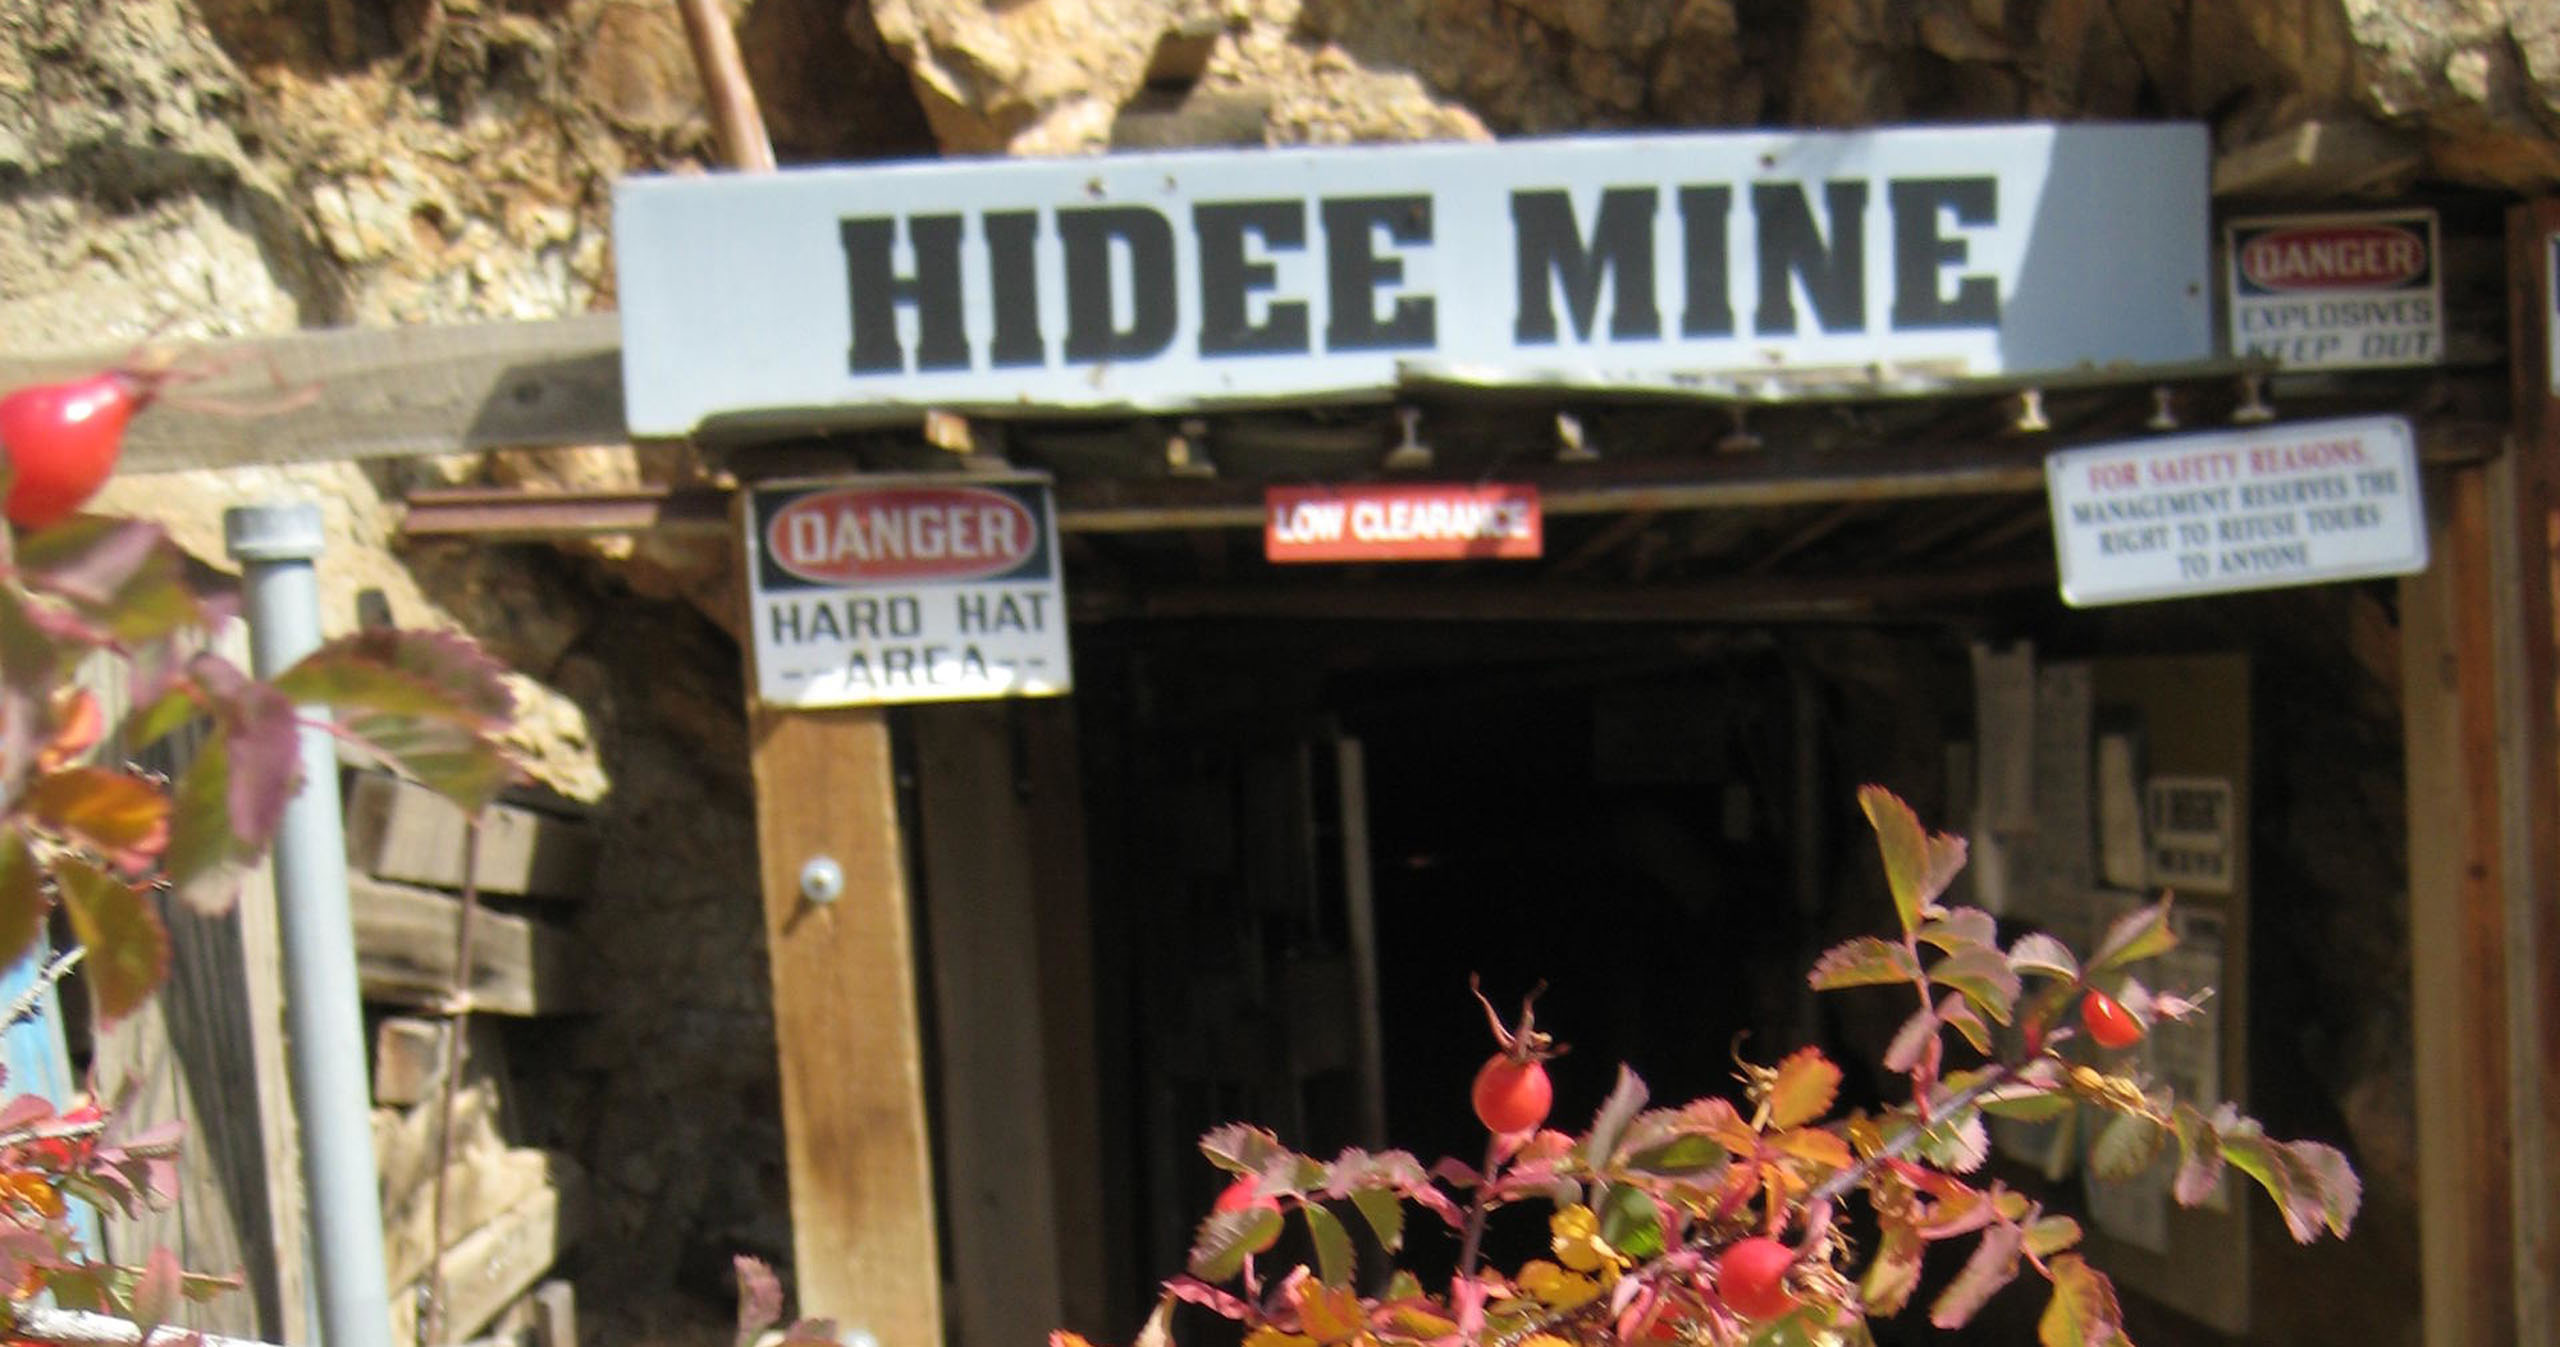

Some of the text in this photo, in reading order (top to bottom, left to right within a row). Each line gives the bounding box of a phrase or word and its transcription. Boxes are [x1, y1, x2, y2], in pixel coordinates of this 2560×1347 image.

[840, 176, 1999, 376] HIDEE MINE
[2251, 237, 2415, 280] DANGER
[2242, 300, 2432, 331] EXPLOSIVES
[2361, 333, 2431, 358] OUT
[2089, 461, 2139, 492] FOR
[2148, 452, 2237, 484] SAFETY
[2072, 470, 2396, 525] MANAGEMENT RESERVES THE
[788, 506, 1018, 564] DANGER
[1275, 499, 1531, 544] LOW CLEARANCE
[2100, 503, 2381, 555] RIGHT TO REFUSE TOURS
[2179, 541, 2307, 578] TO ANYONE
[771, 590, 1050, 643] HARD HAT
[847, 644, 989, 689] AREA
